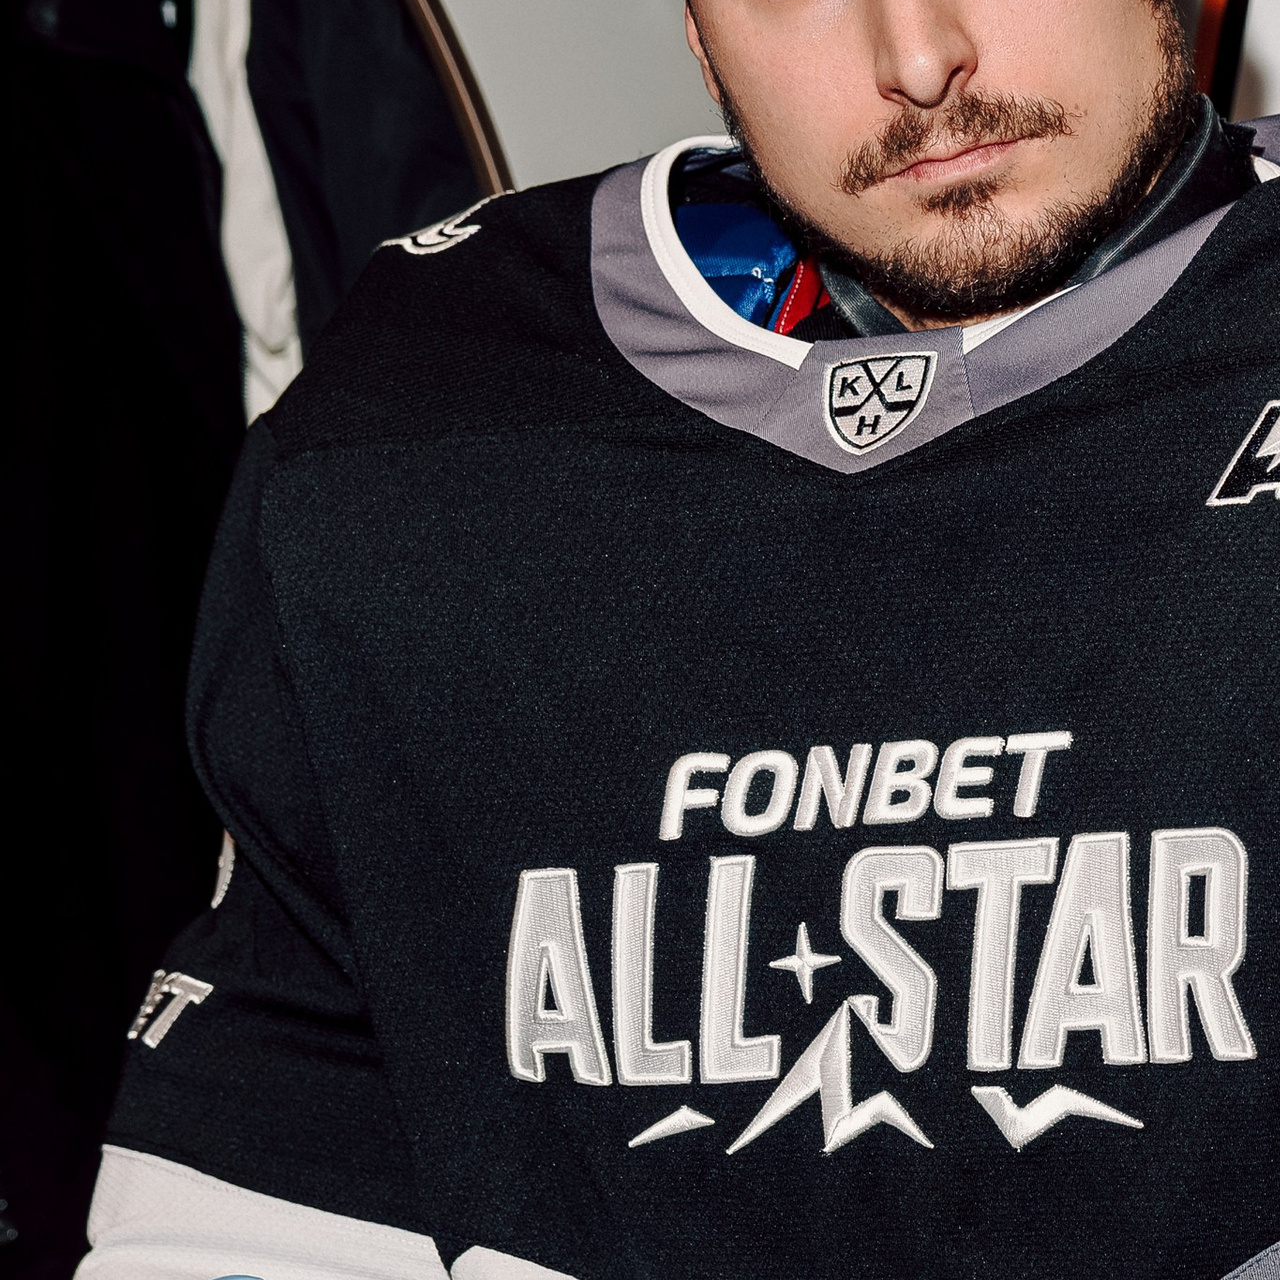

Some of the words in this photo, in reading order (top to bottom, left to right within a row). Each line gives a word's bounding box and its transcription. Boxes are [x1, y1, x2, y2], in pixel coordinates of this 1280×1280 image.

[658, 730, 1075, 842] FONBET
[504, 854, 783, 1087] ALL
[842, 826, 1258, 1074] STAR
